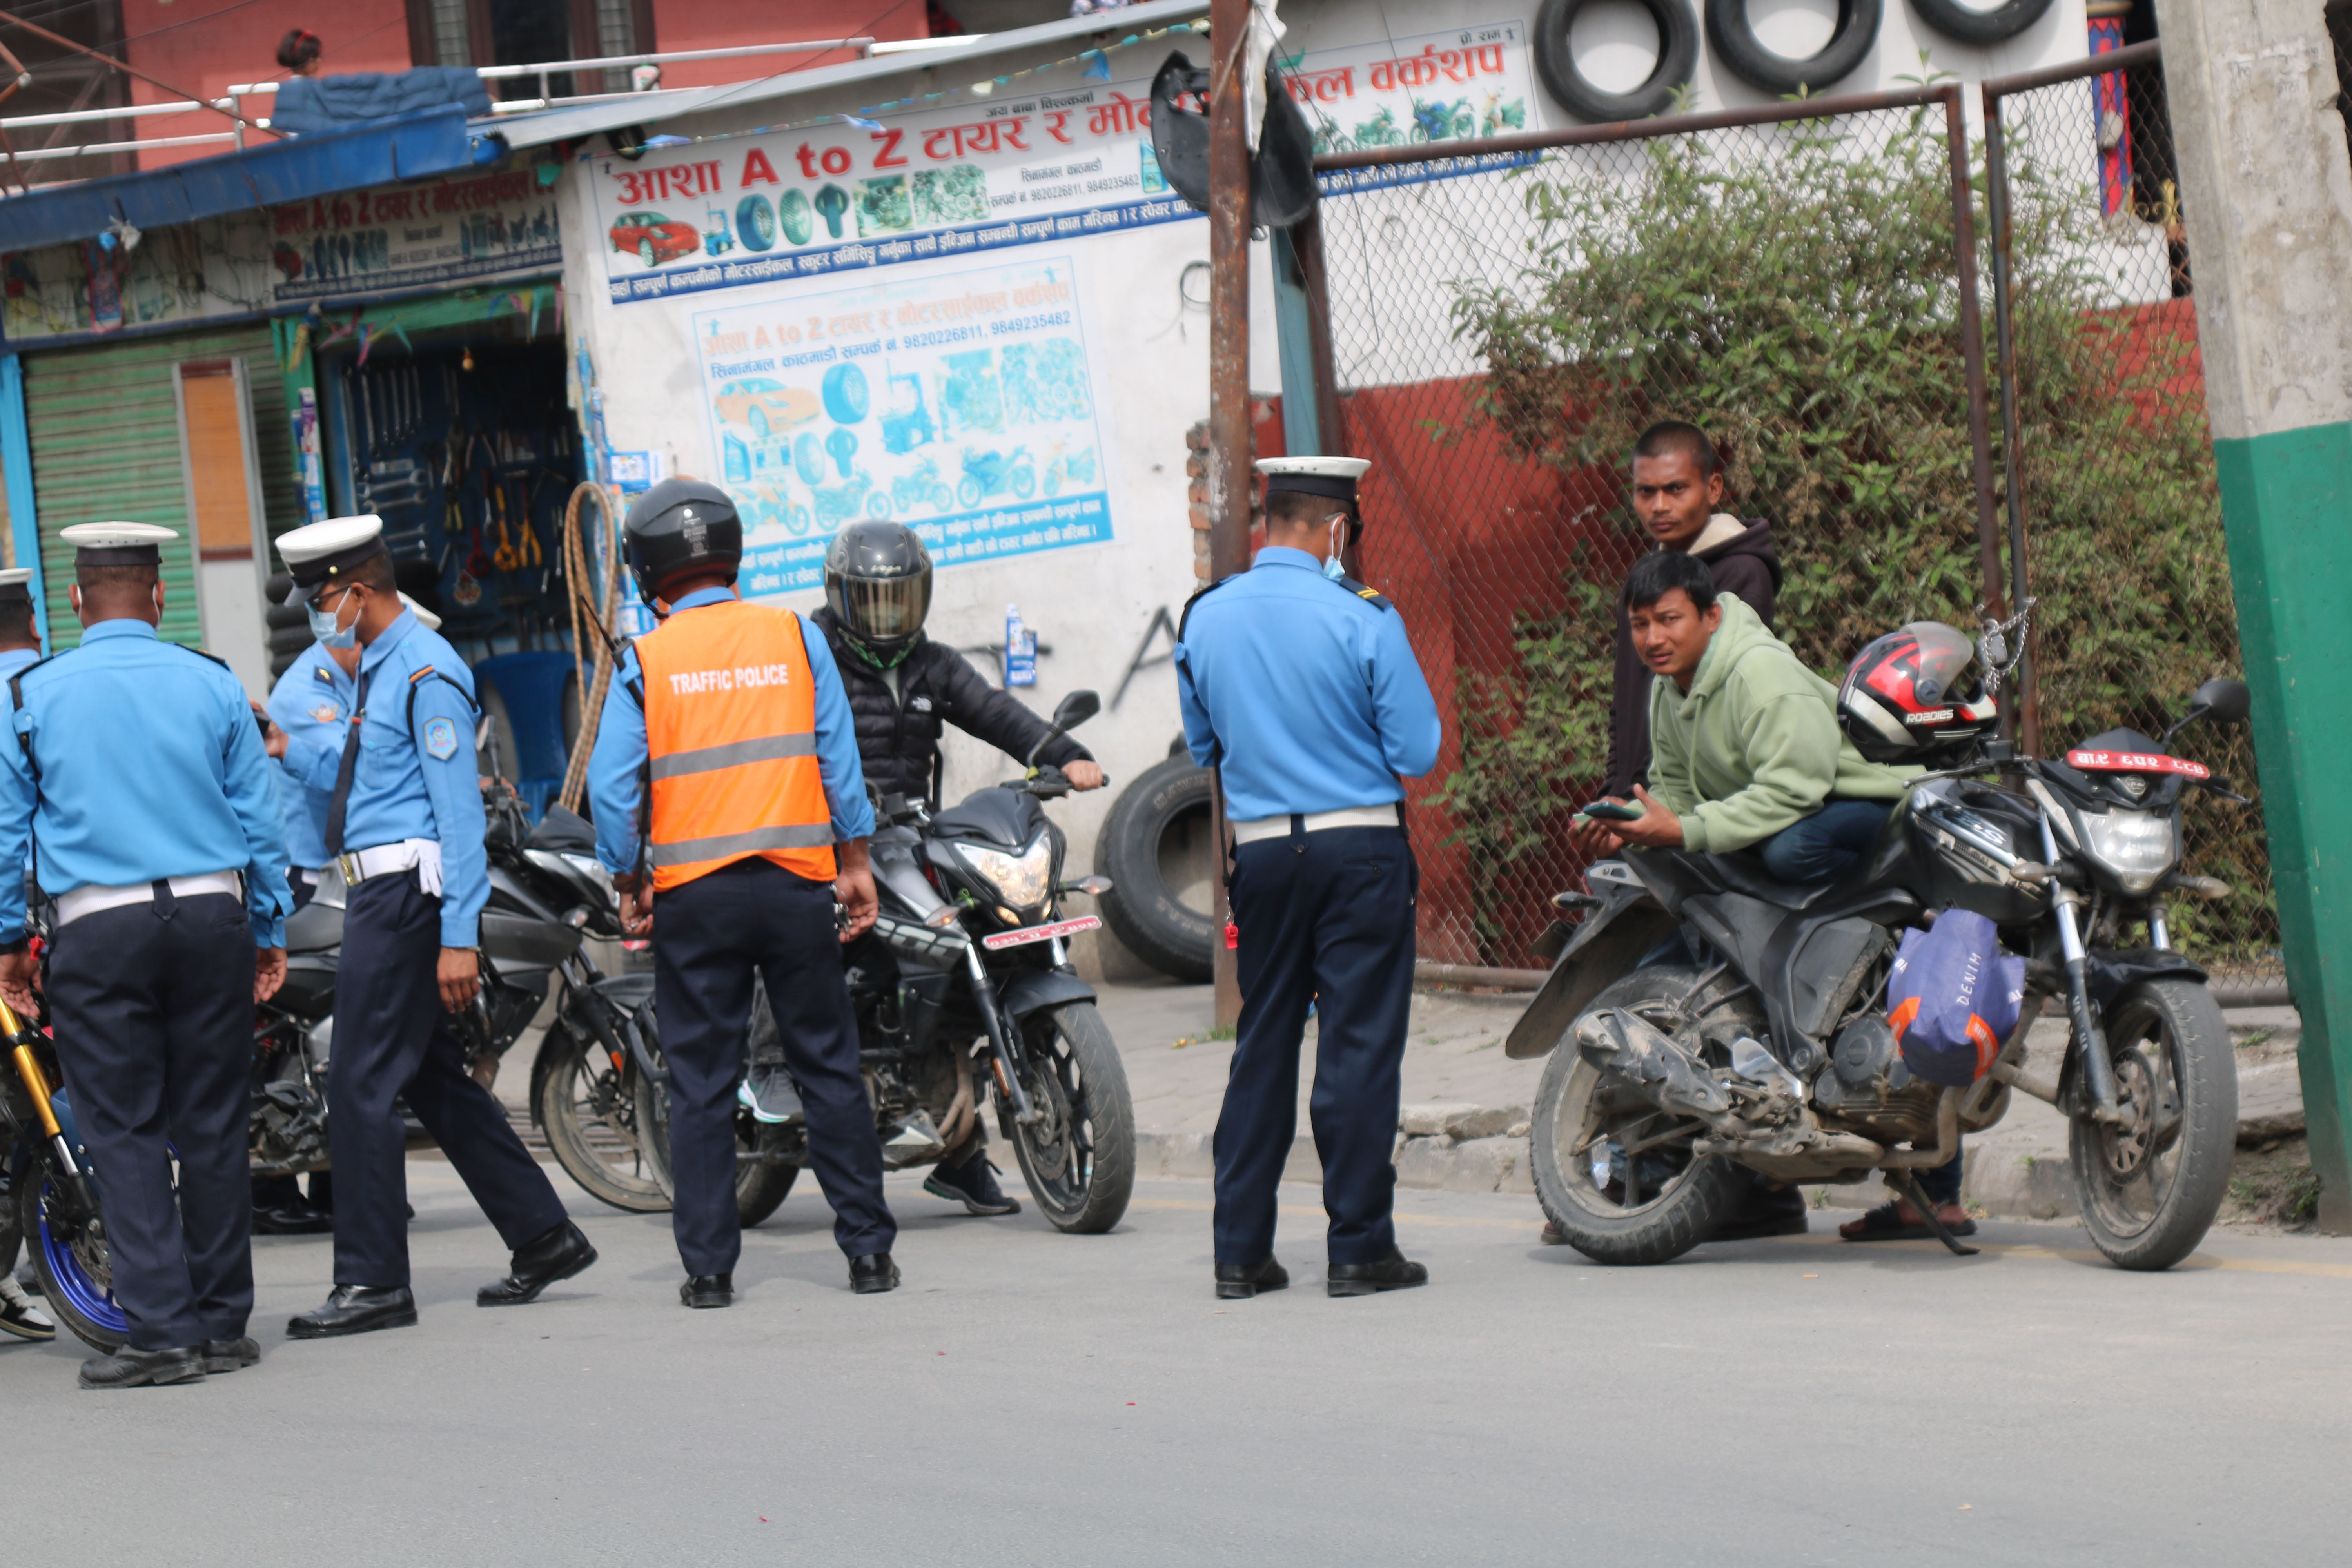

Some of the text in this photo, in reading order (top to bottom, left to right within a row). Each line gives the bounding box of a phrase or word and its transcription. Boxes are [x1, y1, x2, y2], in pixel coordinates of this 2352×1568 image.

[1013, 102, 1036, 116] बाबा
[613, 159, 723, 205] आशा
[740, 147, 780, 188] A
[795, 142, 853, 179] to
[871, 128, 909, 169] Z
[921, 115, 1031, 161] टायर
[1044, 109, 1074, 144] र
[1369, 43, 1506, 92] वर्कशप
[1087, 174, 1139, 194] 9849235482
[1057, 216, 1082, 233] काम
[754, 325, 772, 348] A
[777, 323, 800, 344] to
[807, 316, 824, 339] Z
[828, 311, 873, 336] टायर
[991, 310, 1072, 334] 9849235482
[670, 664, 789, 695] TRAFFIC POLICE
[1906, 709, 1954, 724] ROADIES
[1956, 952, 1982, 1006] DENIM
